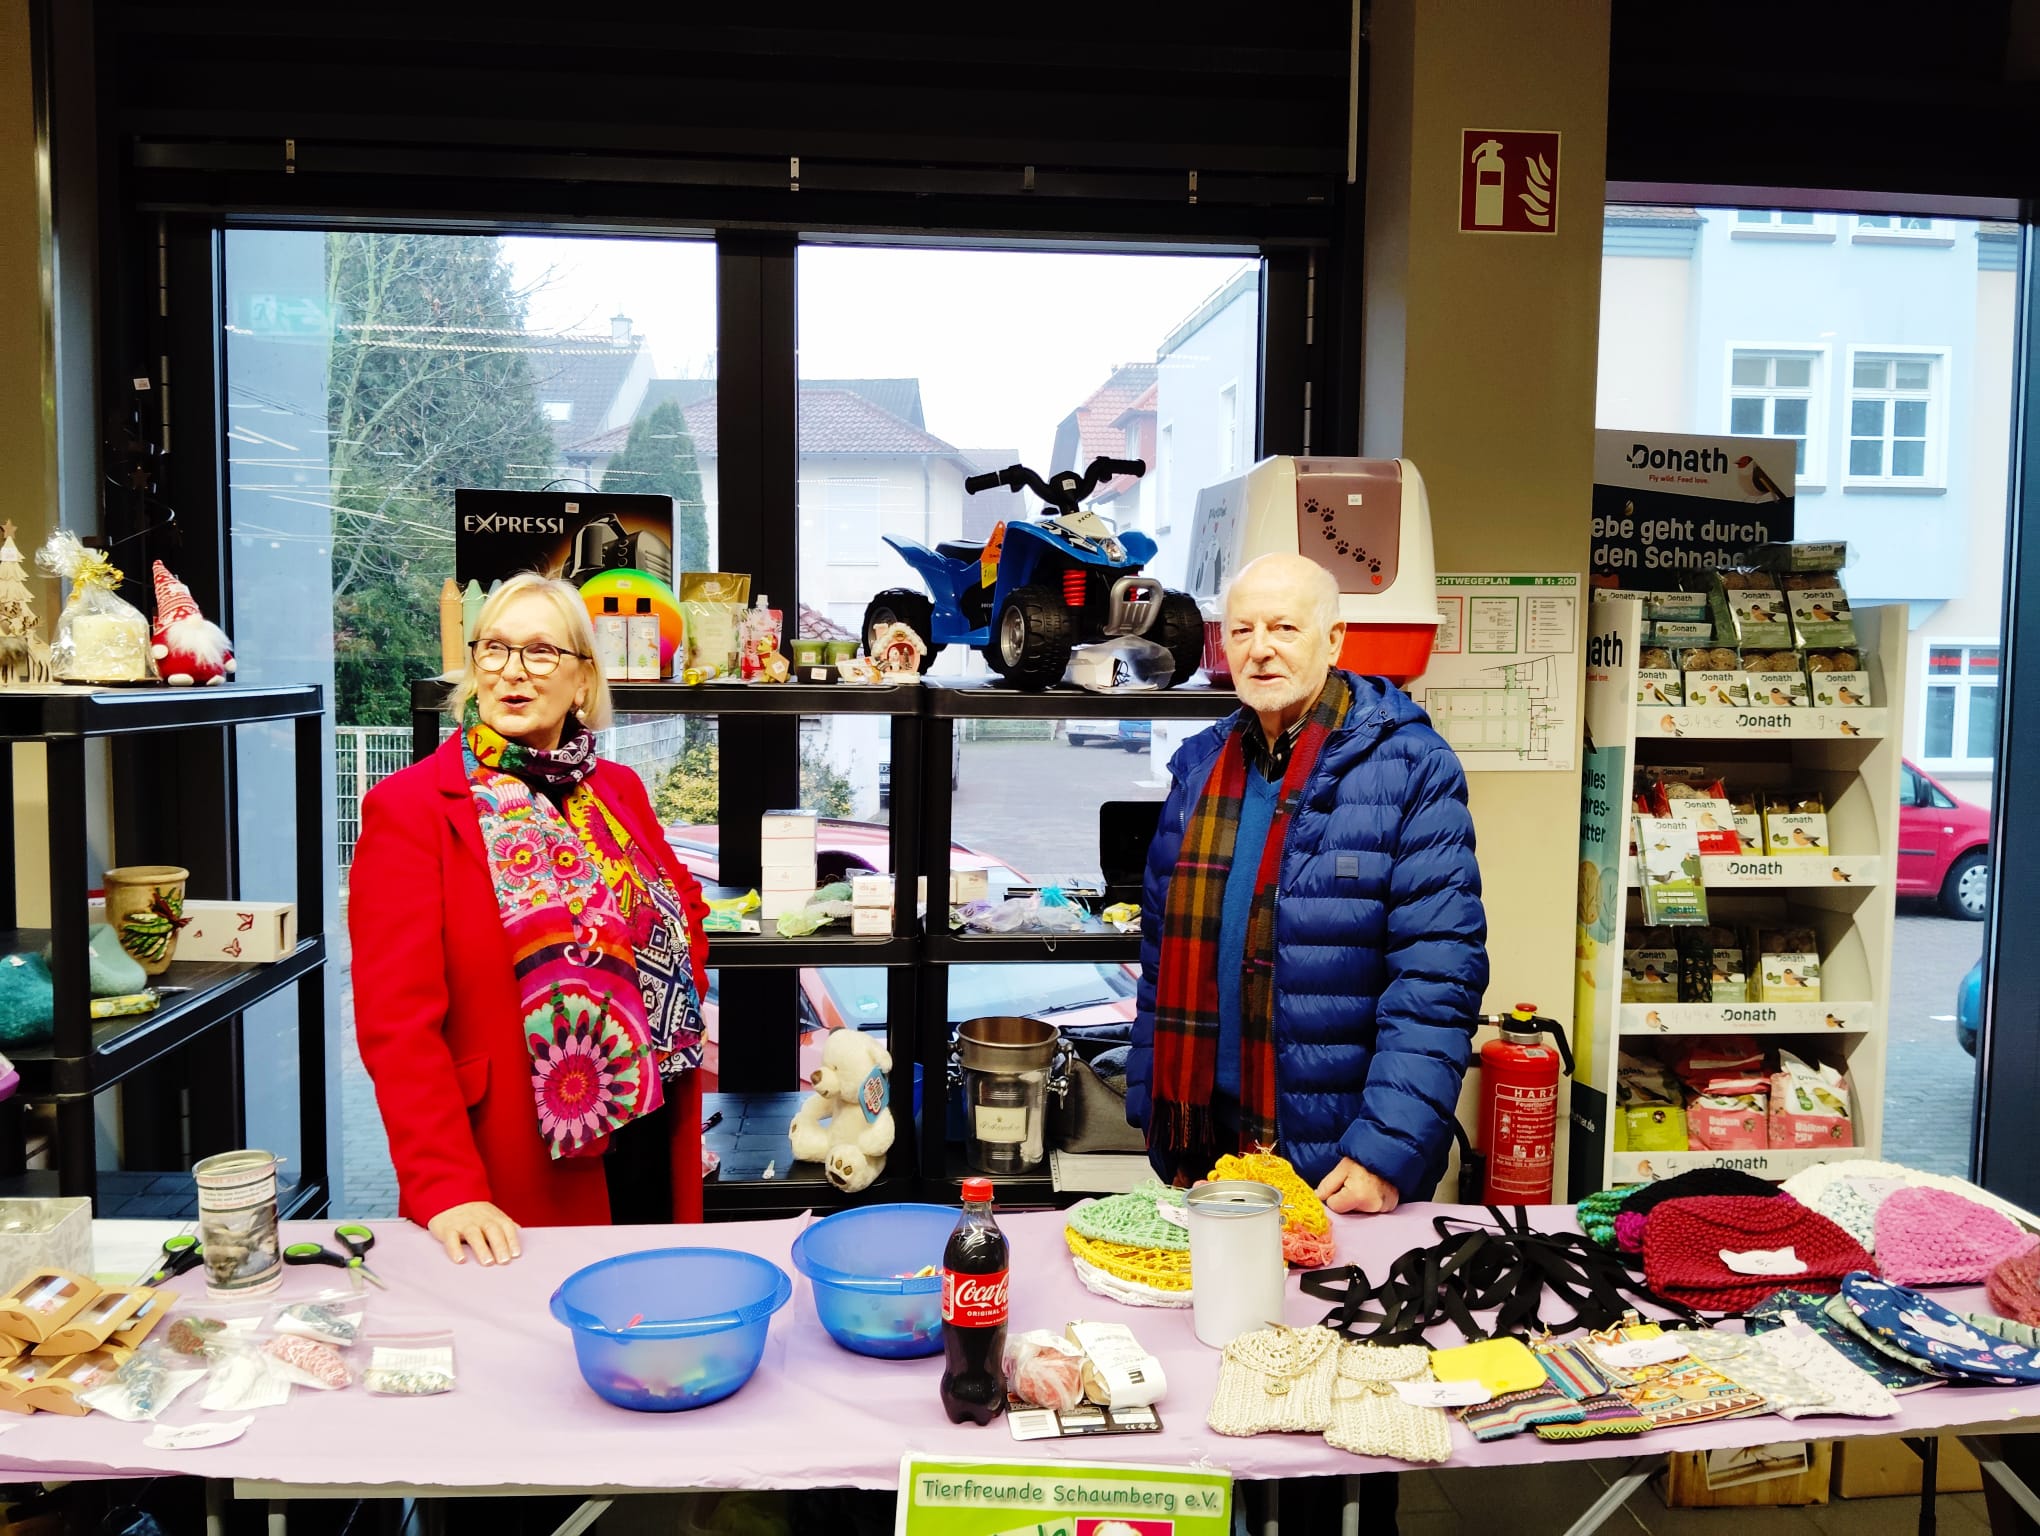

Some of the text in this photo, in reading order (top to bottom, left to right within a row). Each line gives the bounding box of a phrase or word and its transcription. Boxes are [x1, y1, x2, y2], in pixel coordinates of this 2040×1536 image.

[1626, 444, 1729, 474] Donath
[464, 512, 564, 535] EXPRESSI
[1591, 515, 1769, 545] ebe geht durch
[1594, 544, 1745, 570] den Schnabe
[1736, 714, 1792, 729] Donath
[1734, 816, 1749, 825] ath
[1727, 862, 1783, 876] Donath
[1720, 1008, 1776, 1023] Donath
[1514, 1088, 1555, 1098] HARZ
[1712, 1156, 1768, 1170] Donath
[966, 1309, 1000, 1317] ORIGINAL
[922, 1480, 1218, 1512] Tierfreunde Schaumberg e.V.
